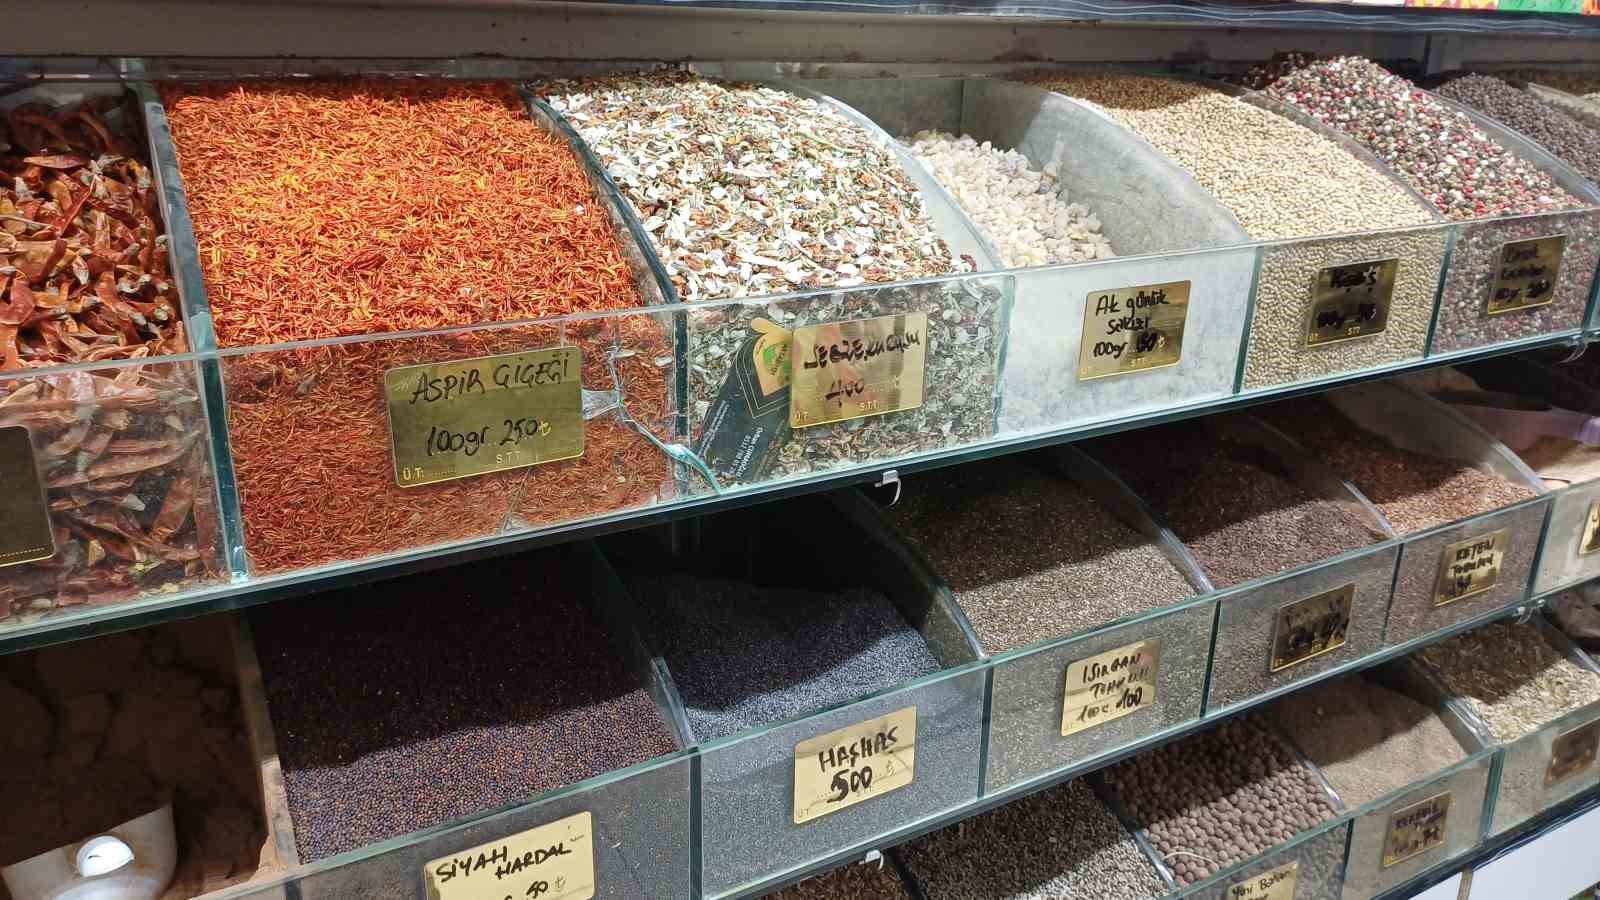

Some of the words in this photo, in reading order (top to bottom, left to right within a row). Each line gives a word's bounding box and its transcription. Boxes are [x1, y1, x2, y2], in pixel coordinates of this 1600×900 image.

[427, 425, 490, 456] 100gr
[826, 765, 873, 804] 500
[494, 843, 572, 880] HARDAL
